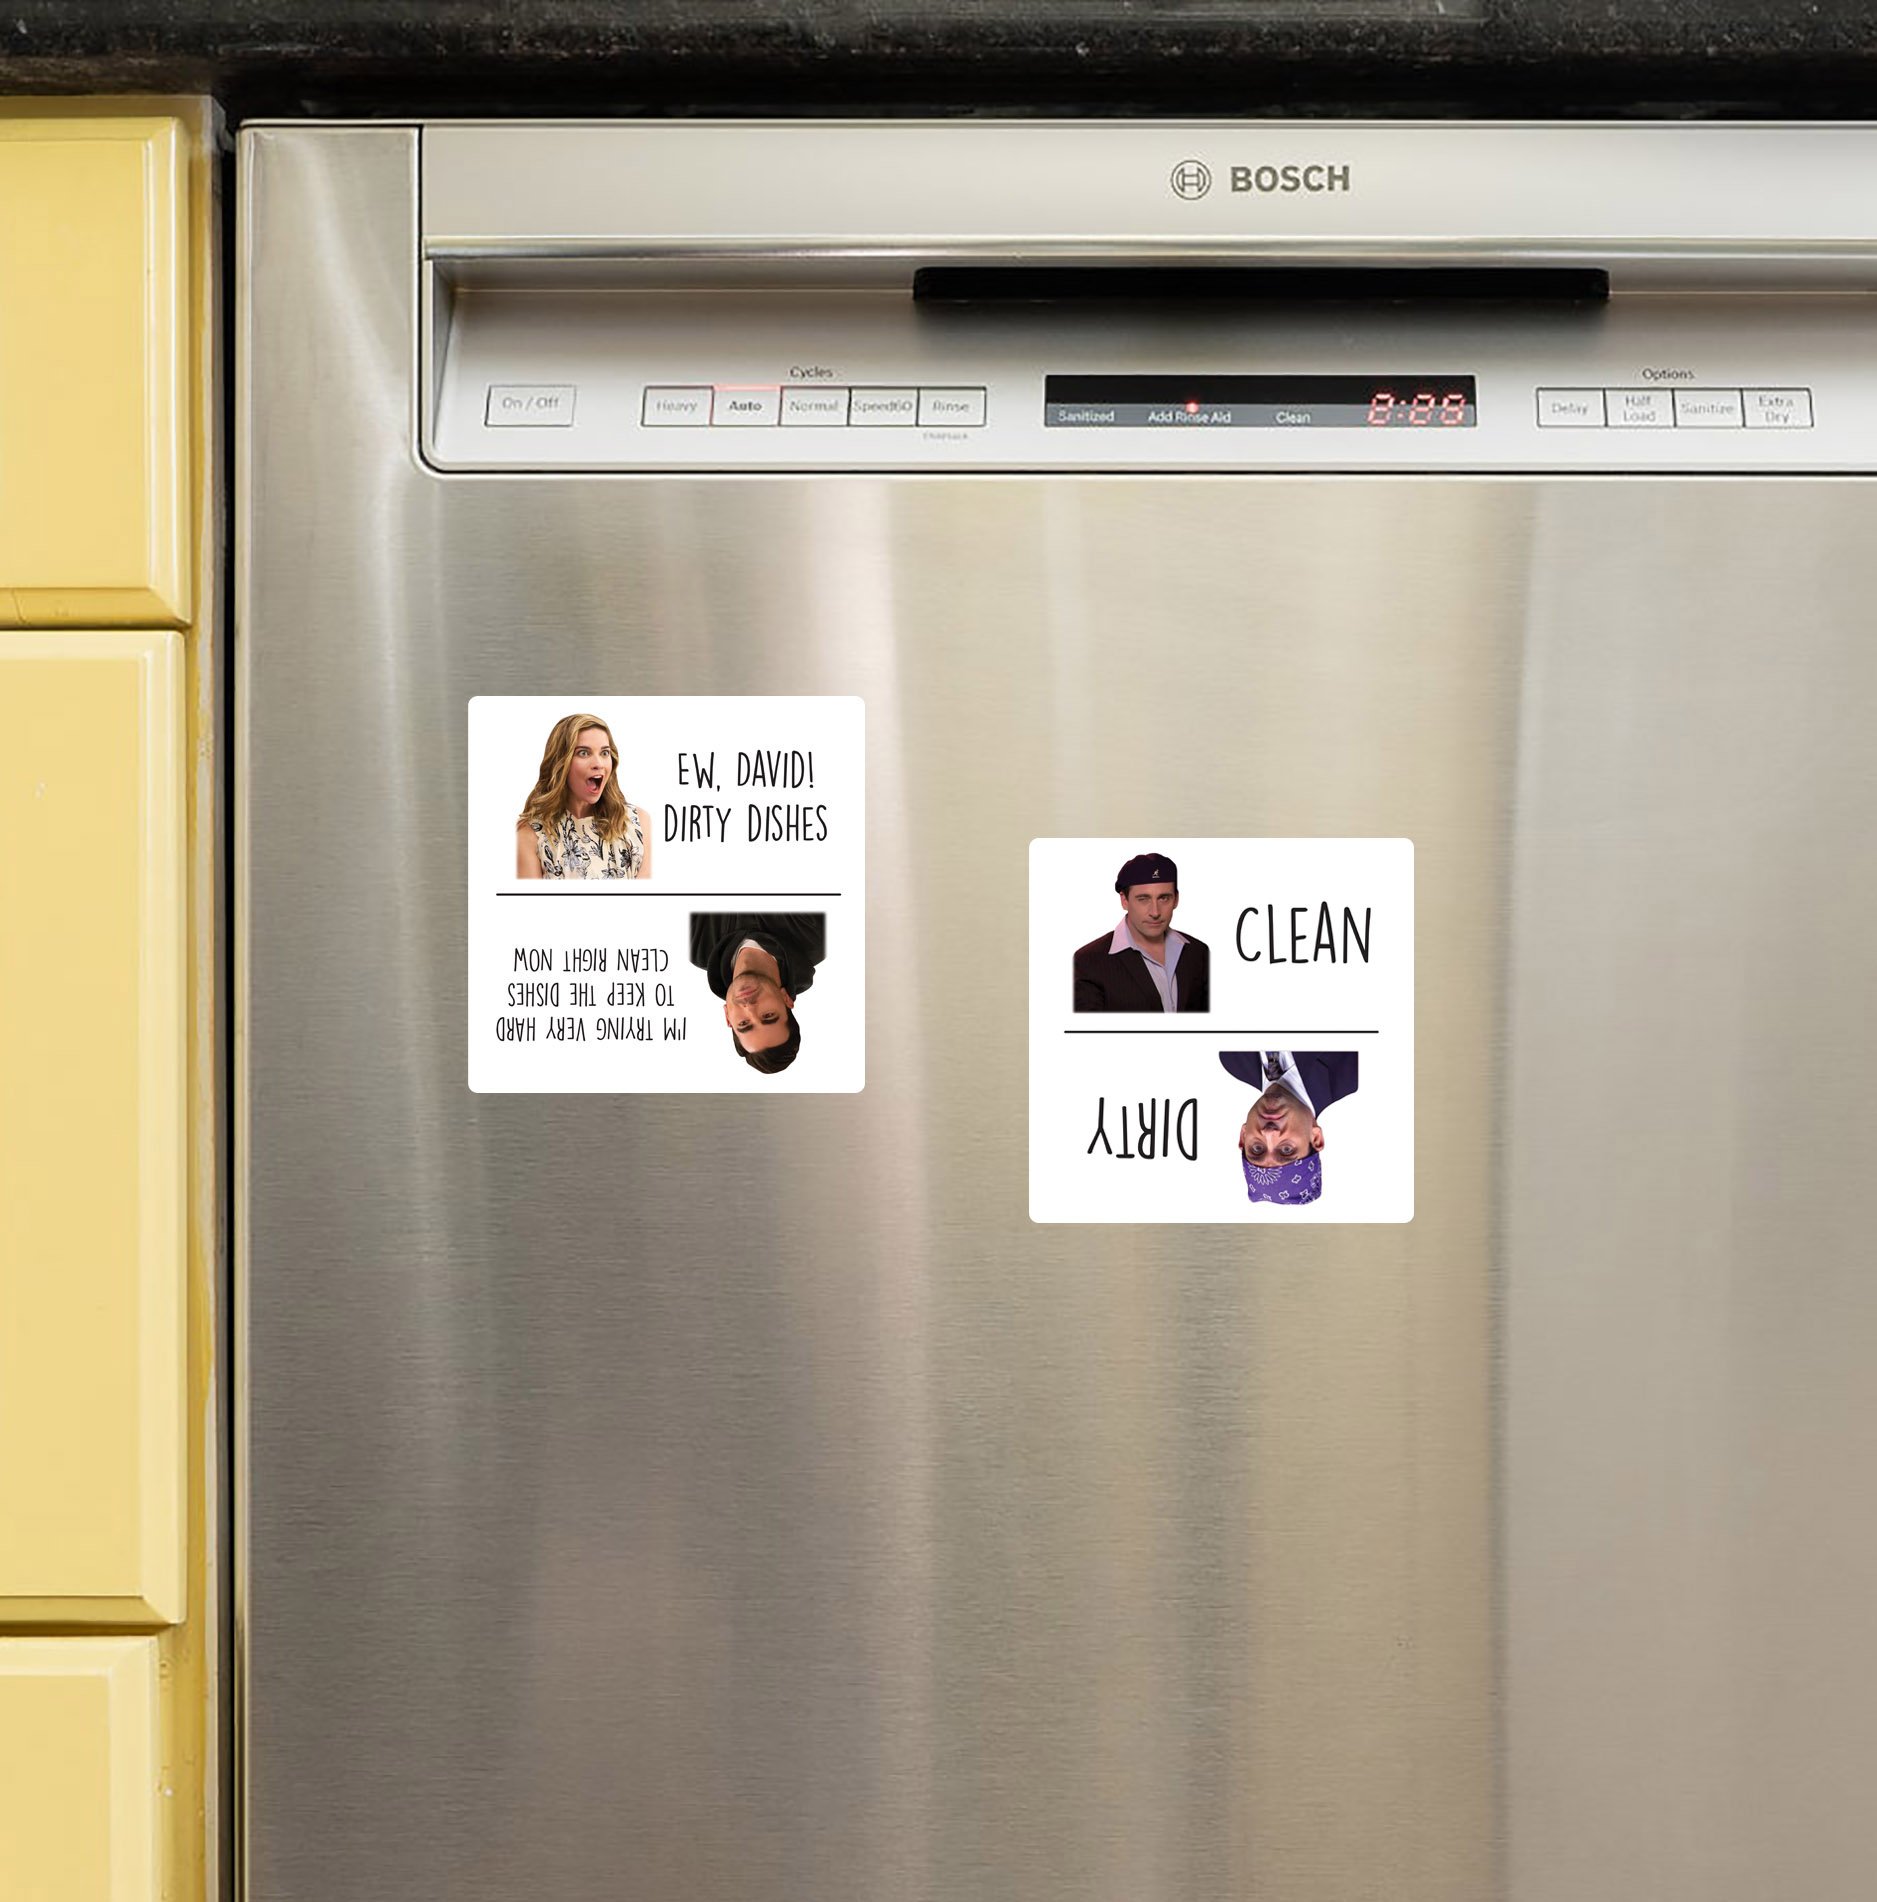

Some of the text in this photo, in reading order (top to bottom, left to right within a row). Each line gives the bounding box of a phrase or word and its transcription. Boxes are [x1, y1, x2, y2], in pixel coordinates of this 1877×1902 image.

[1230, 165, 1350, 192] BOSCH
[789, 366, 834, 381] Cycles
[1642, 367, 1696, 382] Options
[501, 396, 523, 409] On
[536, 396, 560, 409] Off
[655, 400, 698, 414] Heavy
[728, 400, 763, 412] Auto
[789, 400, 839, 412] Normal
[932, 400, 970, 412] Rinse
[1625, 395, 1652, 407] Half
[1680, 401, 1735, 414] Sanitize
[1758, 395, 1795, 408] Extra
[1058, 410, 1115, 422] Sanitized
[1551, 402, 1589, 416] Delay
[1623, 409, 1656, 422] Load
[1148, 411, 1232, 424] Add Rinse Aid
[1275, 411, 1312, 424] Clean
[1765, 410, 1790, 424] Dry
[678, 749, 814, 792] EW, DAVID!
[664, 803, 828, 843] DIRTY DISHES
[1235, 900, 1372, 965] CLEAN
[513, 947, 669, 974] CLEAN RIGHT NOW
[507, 981, 675, 1008] TO KEEP THE DISHES
[495, 1016, 687, 1043] I'M TRYING VERY HARD
[1087, 1096, 1198, 1162] DIRTY
